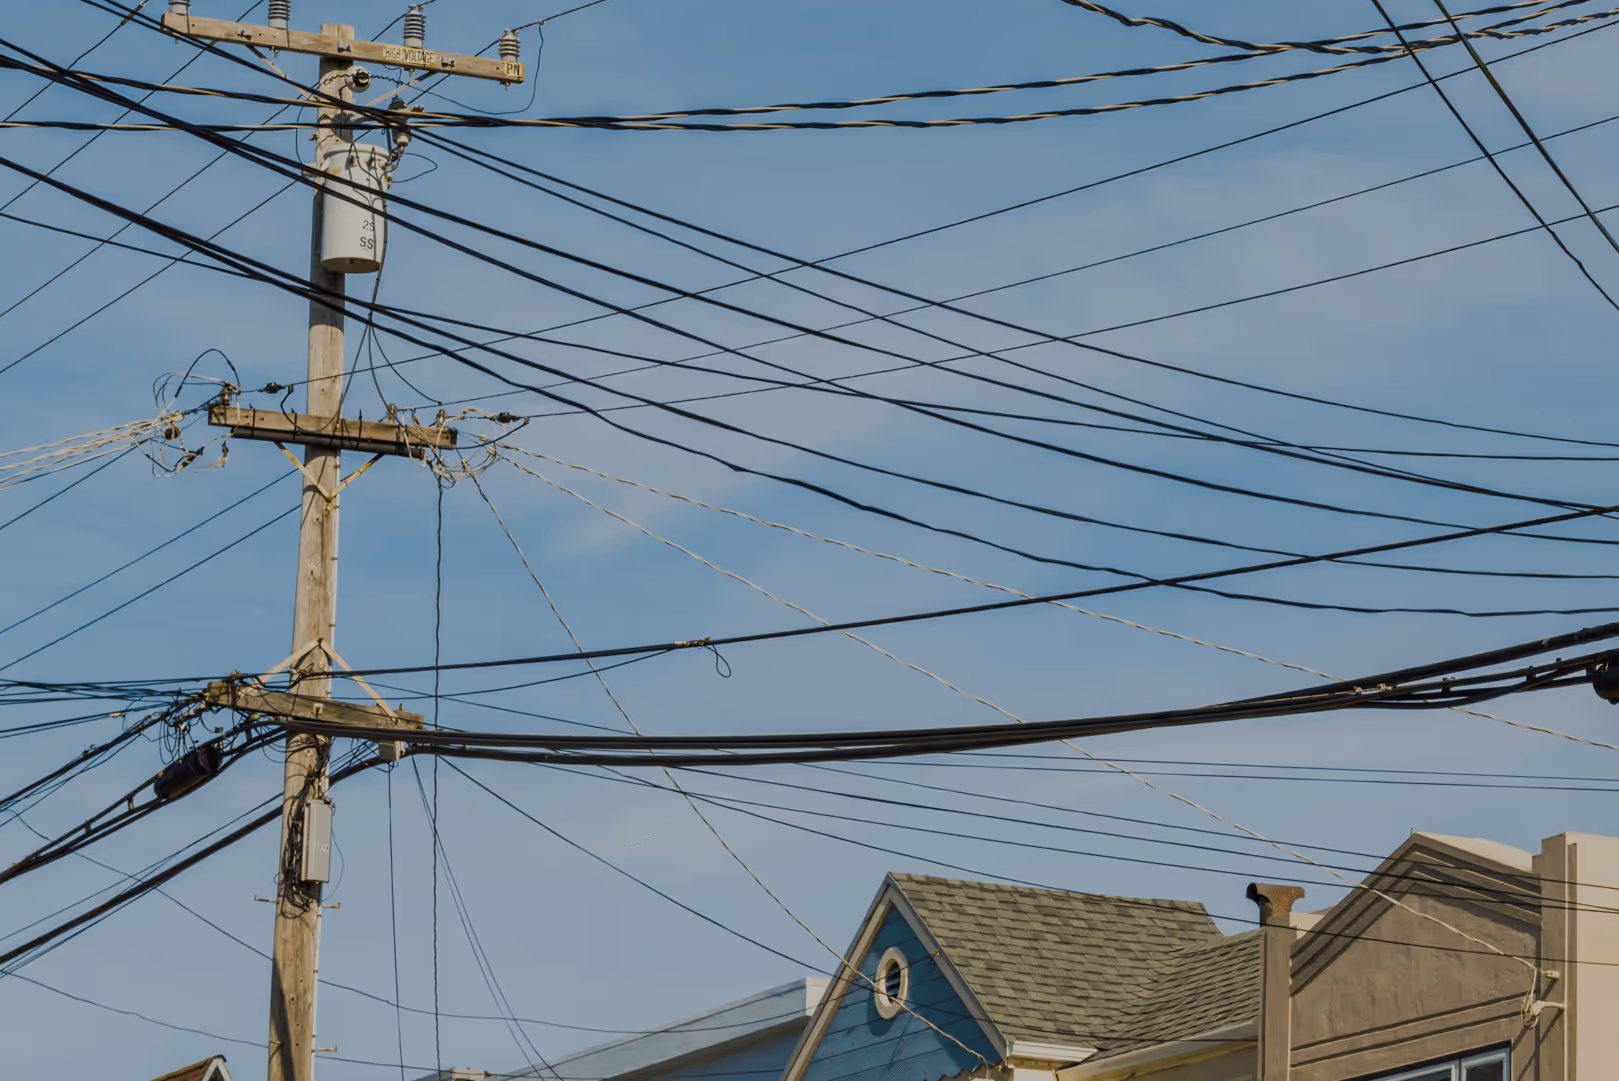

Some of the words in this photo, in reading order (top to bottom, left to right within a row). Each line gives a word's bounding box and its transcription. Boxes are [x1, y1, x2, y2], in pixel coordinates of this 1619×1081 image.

[385, 46, 400, 58] HIGH
[404, 47, 433, 64] VOLTAGE
[506, 63, 520, 76] PN
[360, 236, 374, 249] SS
